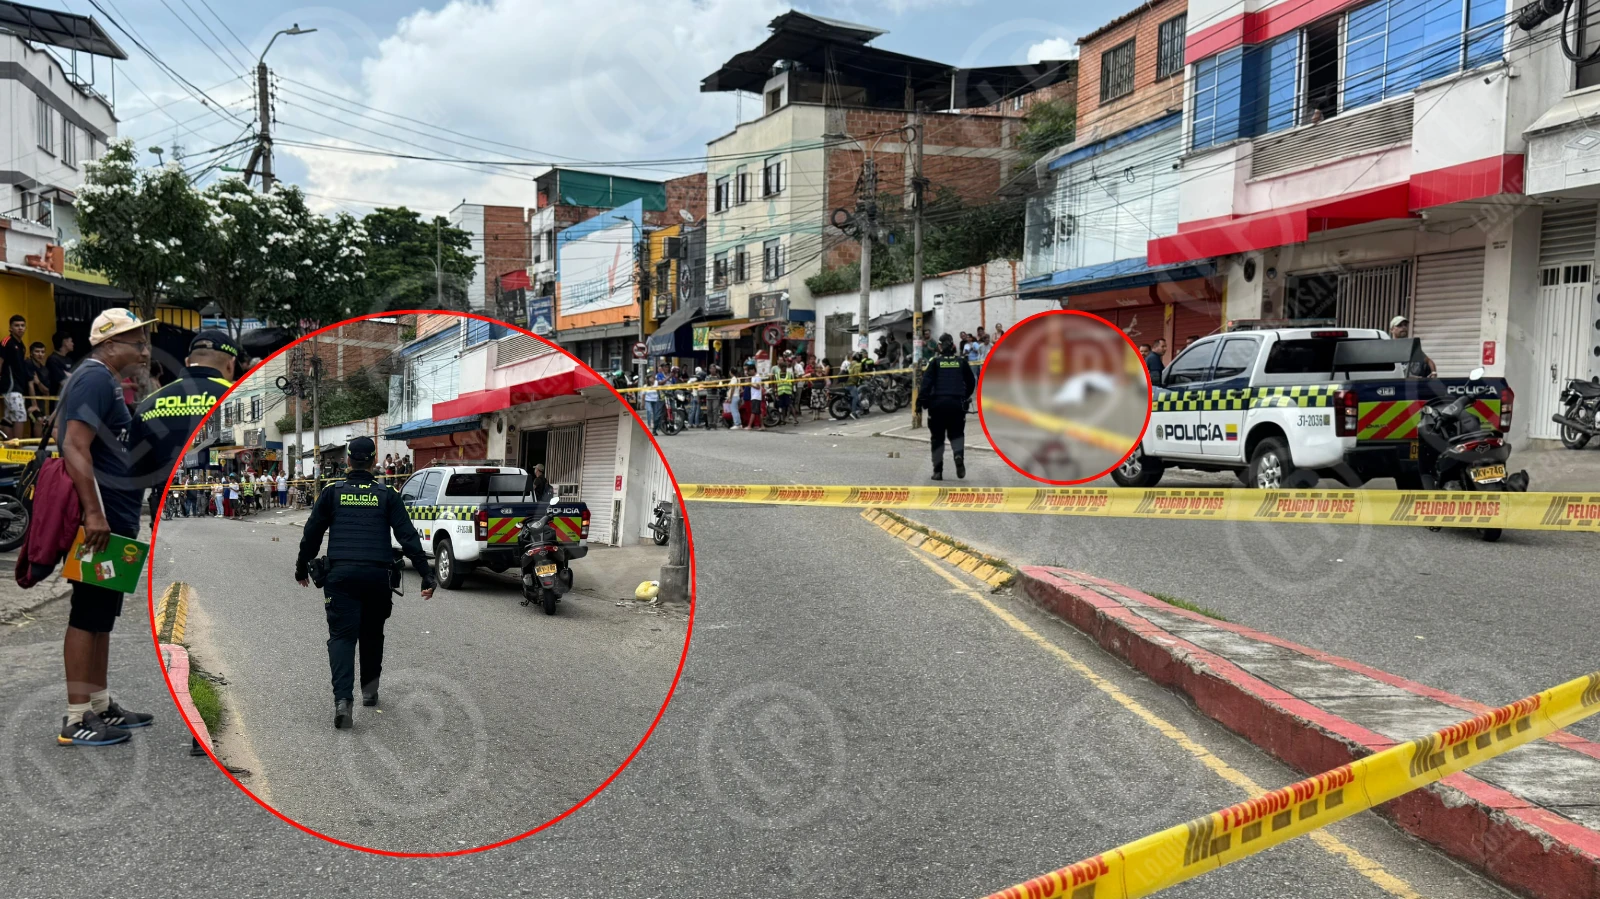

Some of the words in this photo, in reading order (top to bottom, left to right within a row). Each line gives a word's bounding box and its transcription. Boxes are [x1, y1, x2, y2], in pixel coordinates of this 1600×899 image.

[155, 391, 217, 409] POLICÍA
[1165, 423, 1224, 441] POLICÍA
[340, 492, 378, 502] POLICÍA
[778, 489, 800, 499] PELIGRO
[801, 490, 809, 499] NO
[810, 490, 824, 499] PASE
[858, 491, 884, 501] PELIGRO
[885, 491, 894, 502] NO
[895, 492, 909, 502] PASE
[947, 492, 974, 503] PELIGRO
[975, 493, 985, 504] NO
[985, 493, 1003, 504] PASE
[1045, 495, 1076, 506] PELIGRO
[1077, 495, 1089, 506] NO
[1089, 495, 1108, 507] PASE
[1154, 496, 1188, 508] PELIGRO
[1189, 497, 1201, 509] NO
[1202, 497, 1224, 509] PASE
[1277, 499, 1315, 512] PELIGRO
[1316, 499, 1330, 512] NO
[1331, 499, 1355, 513] PASE
[1414, 501, 1456, 516] PELIGRO
[1457, 501, 1472, 516] NO
[1473, 502, 1500, 516] PASE
[1566, 504, 1600, 519] PELIG
